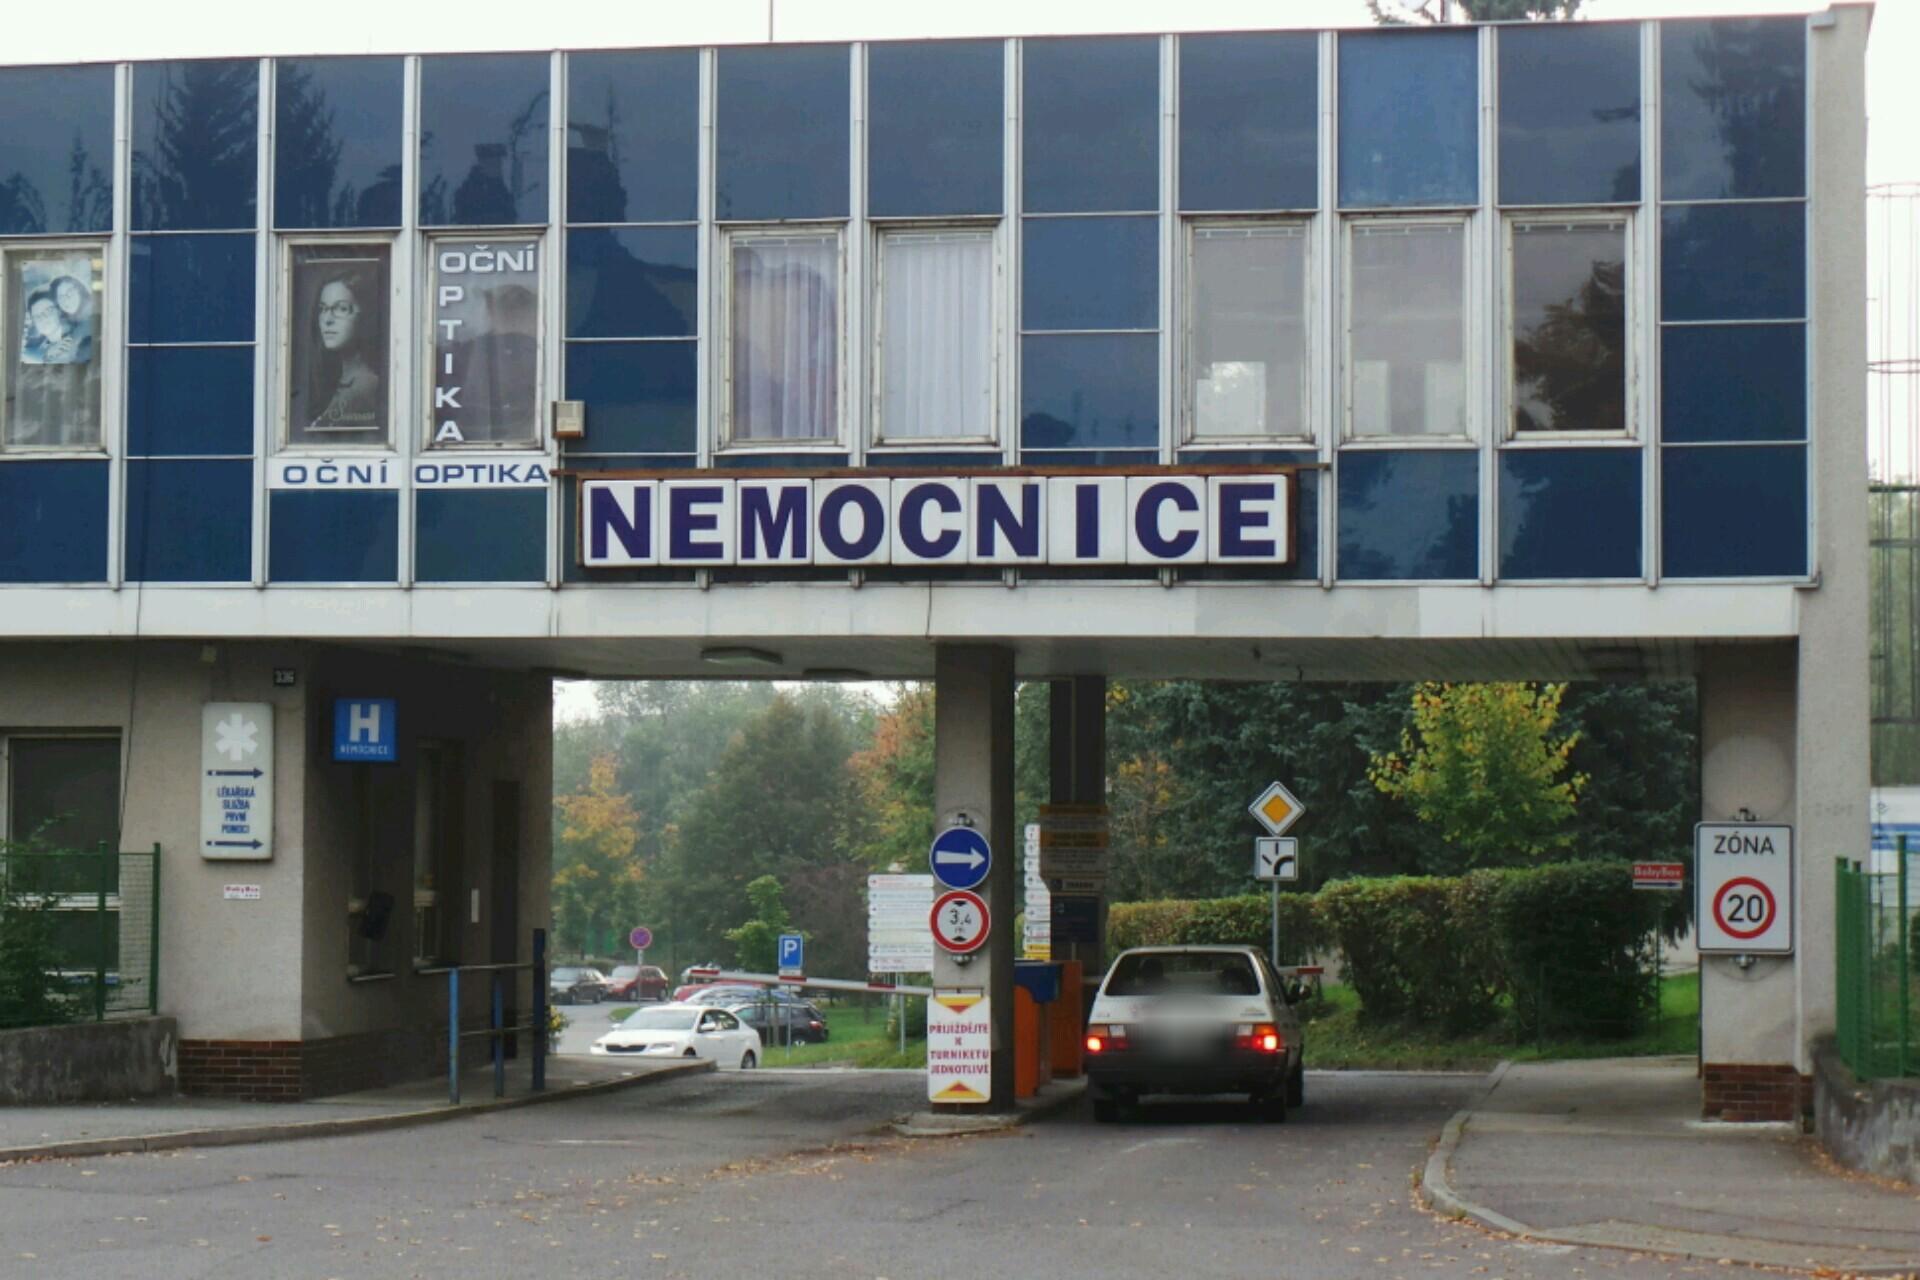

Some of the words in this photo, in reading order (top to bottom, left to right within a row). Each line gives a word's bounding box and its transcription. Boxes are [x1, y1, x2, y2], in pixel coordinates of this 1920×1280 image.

[439, 244, 536, 273] OČNÍ
[283, 458, 388, 484] OČNÍ
[415, 464, 549, 484] OPTIKA
[589, 482, 1277, 559] NEMOCNICE
[350, 704, 381, 743] H
[1714, 831, 1775, 855] ZÓNA
[1728, 894, 1764, 923] 20
[784, 939, 797, 959] P
[931, 1050, 990, 1060] TURNIKETU
